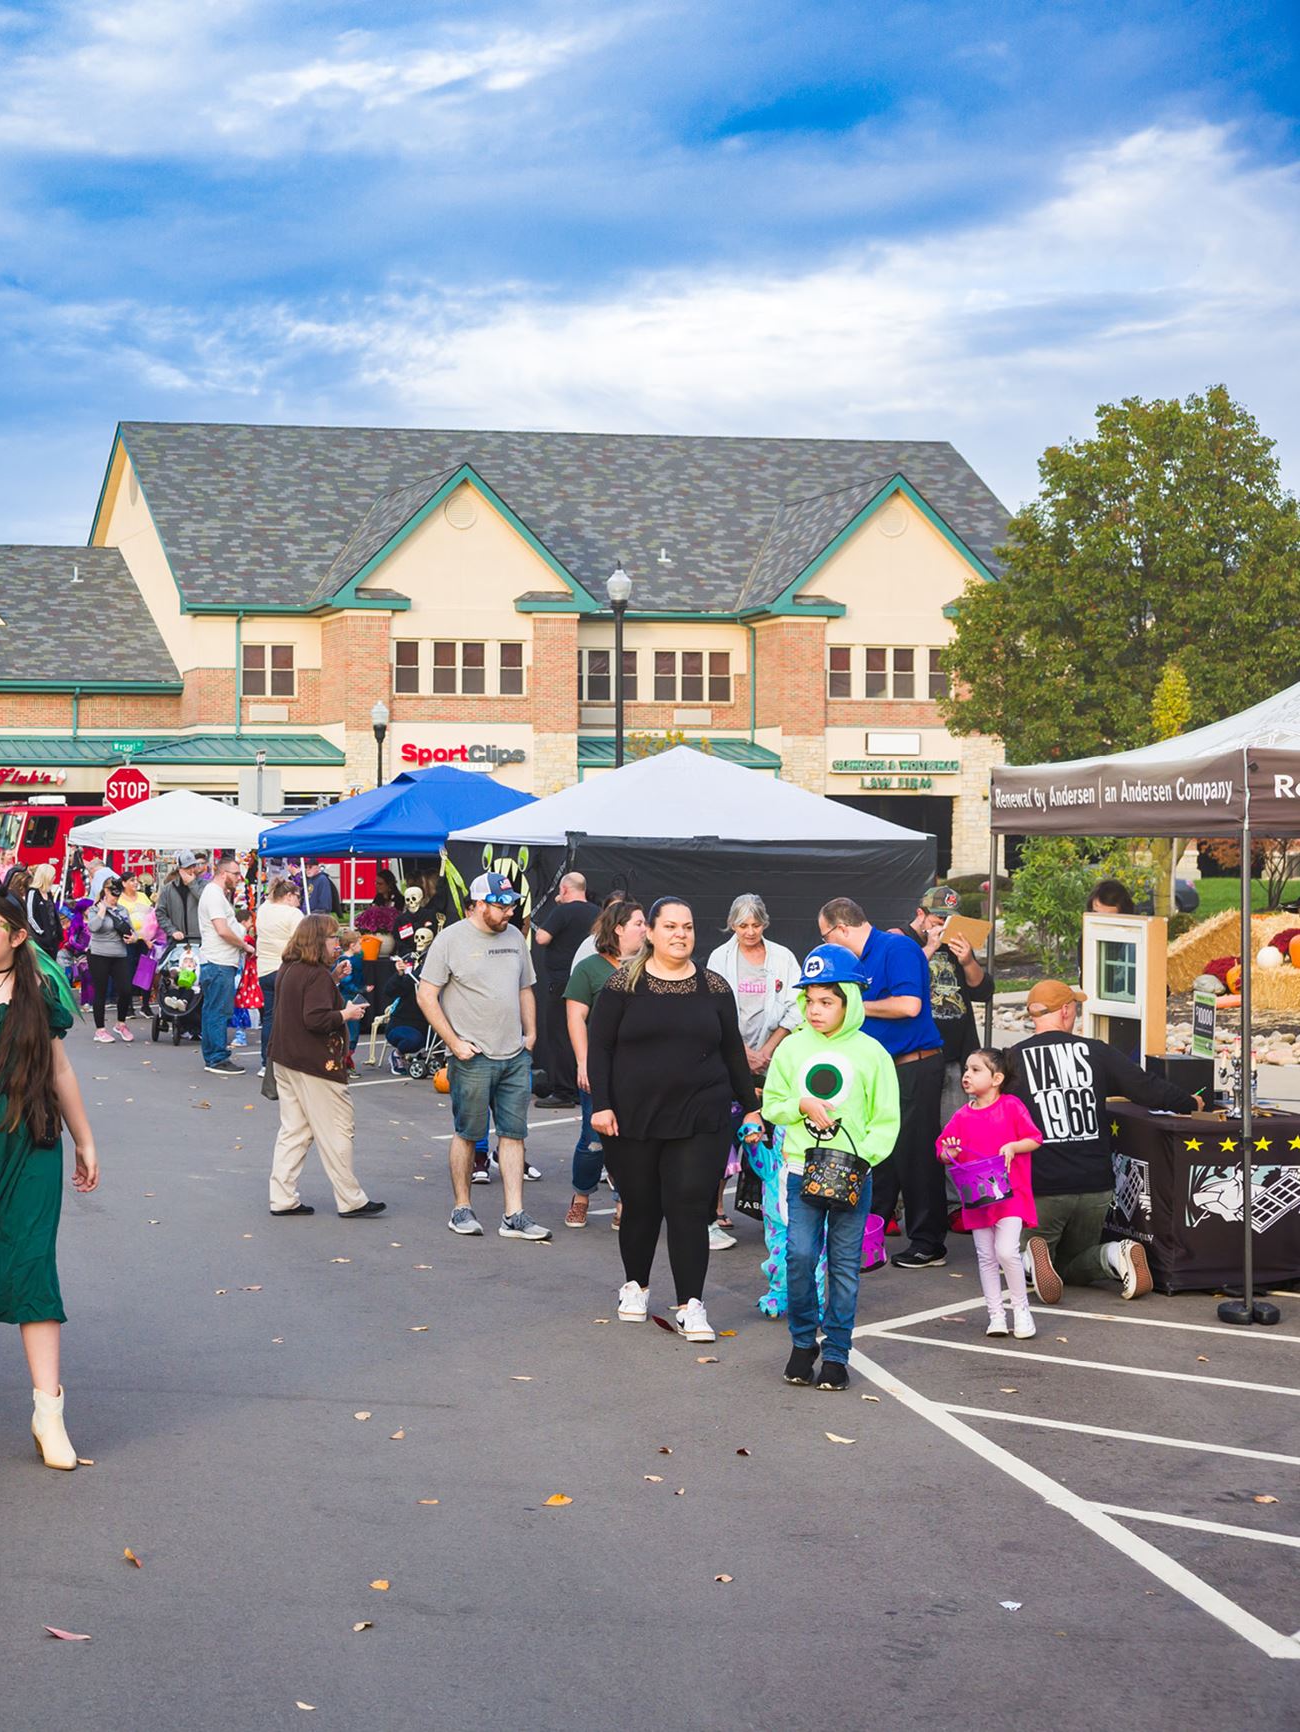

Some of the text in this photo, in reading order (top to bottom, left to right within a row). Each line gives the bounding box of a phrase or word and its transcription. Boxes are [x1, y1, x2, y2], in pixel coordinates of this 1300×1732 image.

[401, 743, 526, 766] SportClips
[108, 781, 148, 799] STOP
[860, 777, 932, 790] LAW FIRM
[995, 777, 1232, 813] Renewal by Andersen an Andersen Company
[1022, 1042, 1093, 1095] VANS
[1034, 1088, 1098, 1139] 1966
